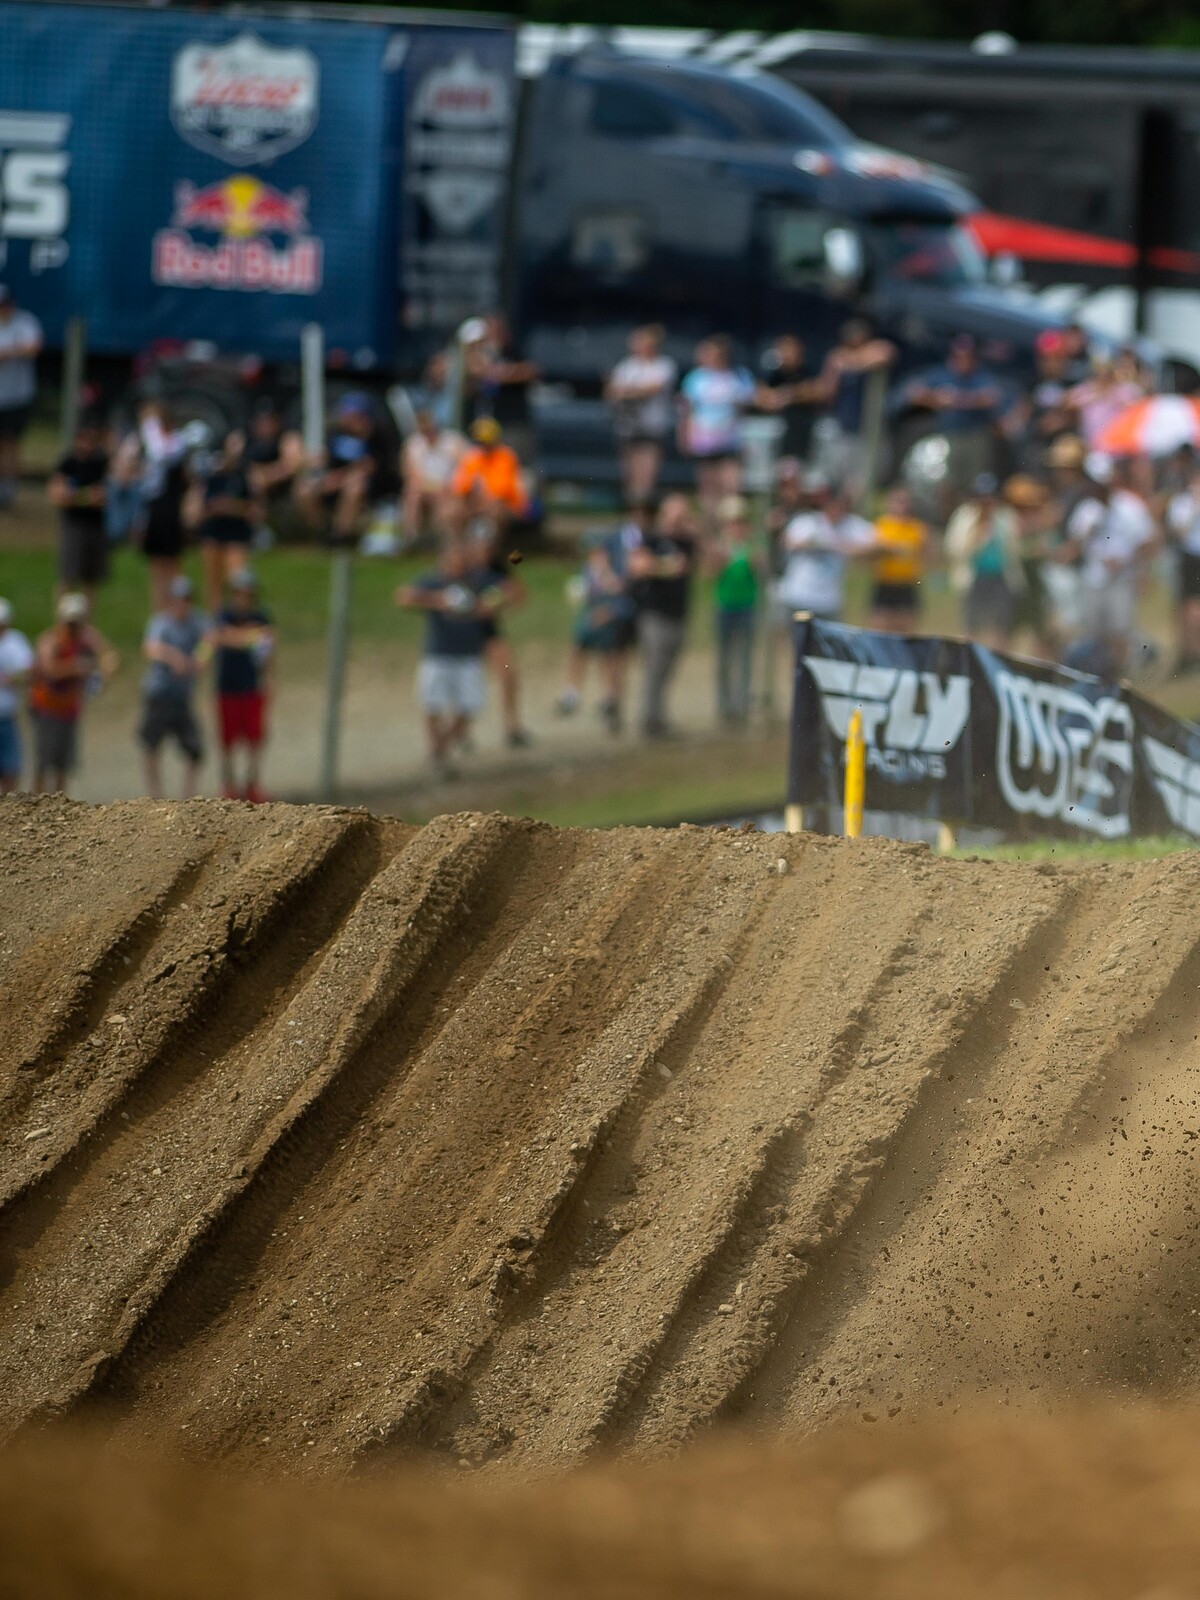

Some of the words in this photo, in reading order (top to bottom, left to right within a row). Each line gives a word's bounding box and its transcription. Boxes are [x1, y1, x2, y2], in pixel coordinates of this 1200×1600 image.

[153, 228, 236, 289] Red
[238, 233, 323, 295] Bull
[802, 655, 971, 754] FLY
[842, 747, 948, 779] ACING
